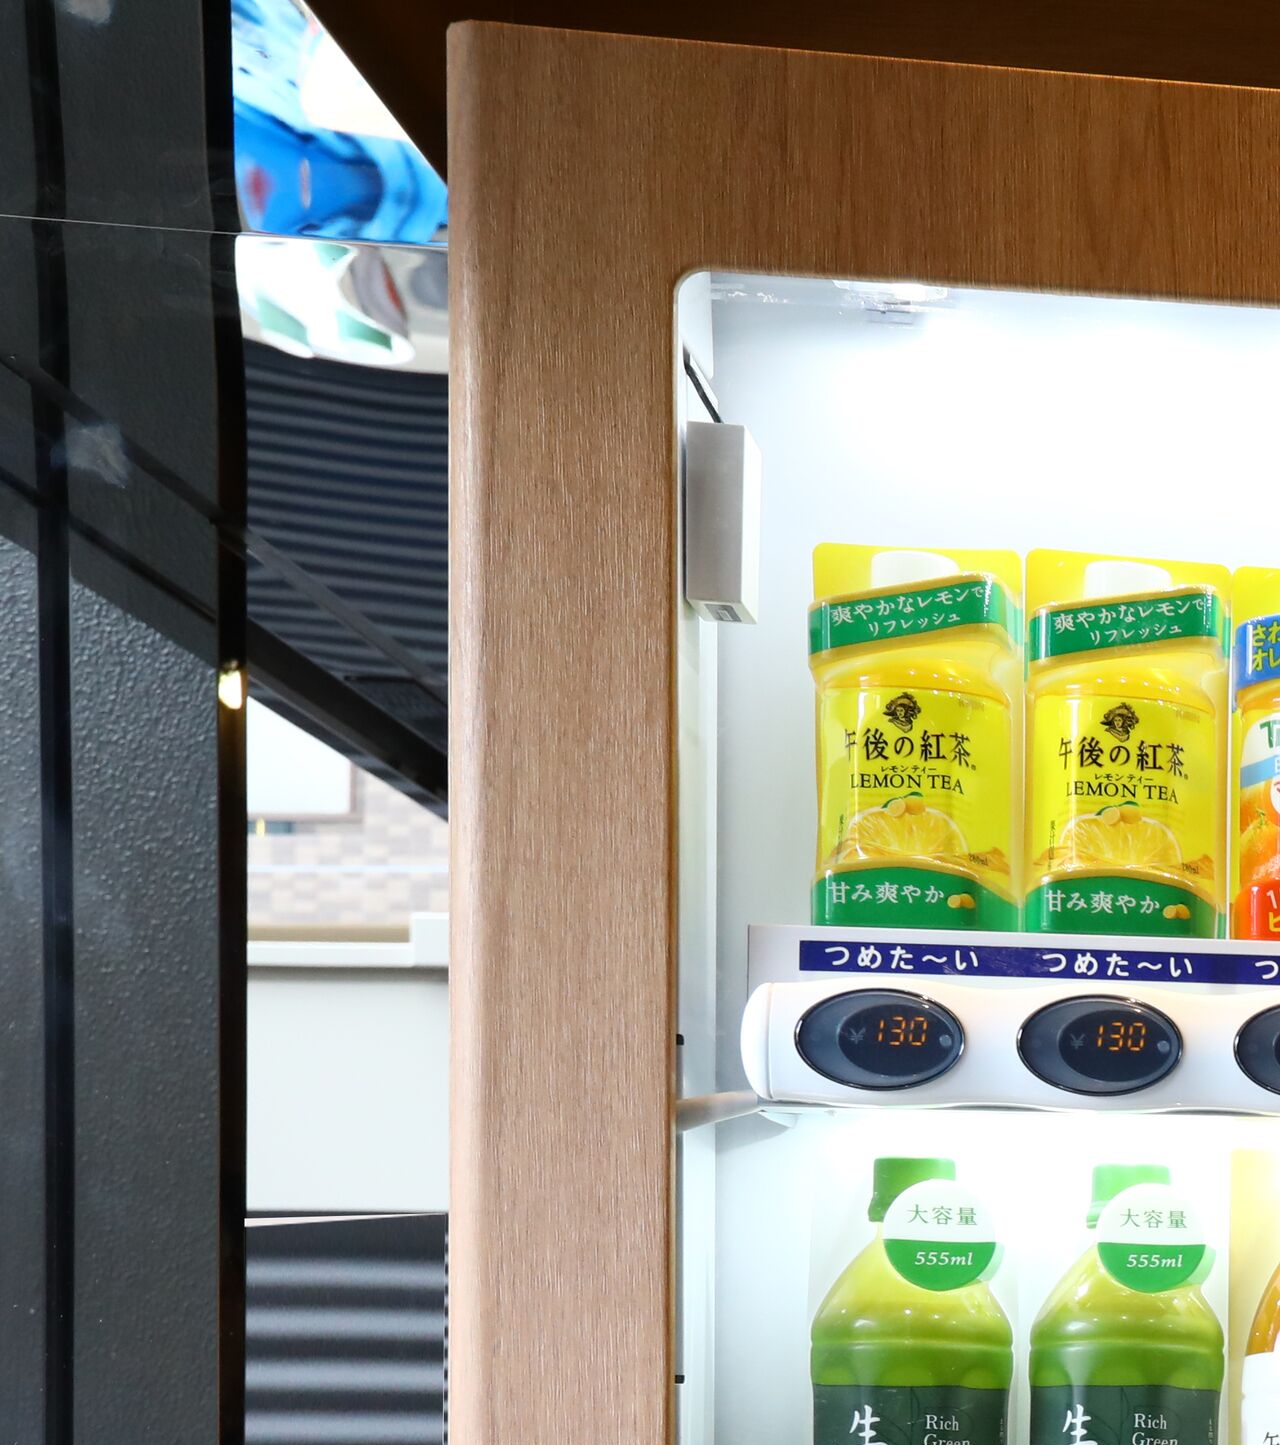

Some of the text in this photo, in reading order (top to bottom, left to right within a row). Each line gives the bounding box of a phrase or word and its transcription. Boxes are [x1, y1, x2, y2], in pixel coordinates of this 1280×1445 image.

[868, 610, 960, 637] リフレッシュ
[845, 728, 971, 767] 午後の紅茶
[880, 765, 937, 774] レモンティー
[850, 774, 964, 795] LEMON TEA
[828, 881, 944, 904] 甘み爽やか
[876, 1017, 928, 1047] 130
[907, 1205, 978, 1226] 大容量
[914, 1251, 974, 1268] 555ml
[924, 1414, 959, 1431] Rich
